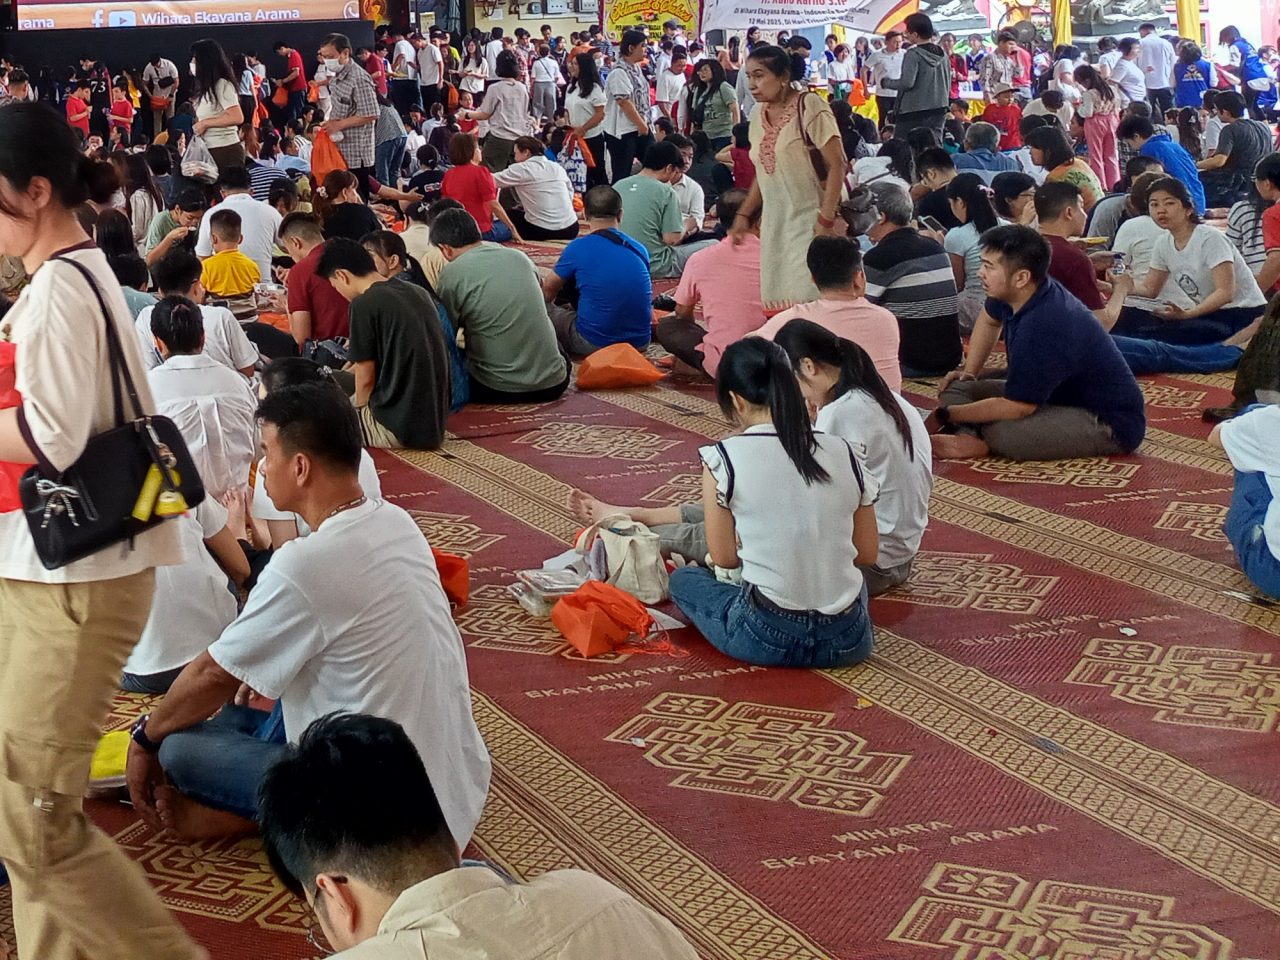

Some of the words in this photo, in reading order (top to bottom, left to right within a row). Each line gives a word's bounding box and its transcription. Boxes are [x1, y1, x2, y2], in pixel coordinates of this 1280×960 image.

[141, 12, 192, 26] Wihara
[194, 10, 252, 25] Ekayana
[255, 8, 300, 22] Arama
[758, 7, 780, 16] Ekayana
[748, 17, 756, 25] 12
[90, 80, 106, 93] 73
[524, 679, 653, 700] EKAYANA
[678, 664, 768, 683] ARAMA
[587, 664, 685, 683] WIHARA
[831, 820, 954, 845] WIHARA
[760, 842, 920, 870] EKAYANA
[949, 822, 1059, 847] ARAMA
